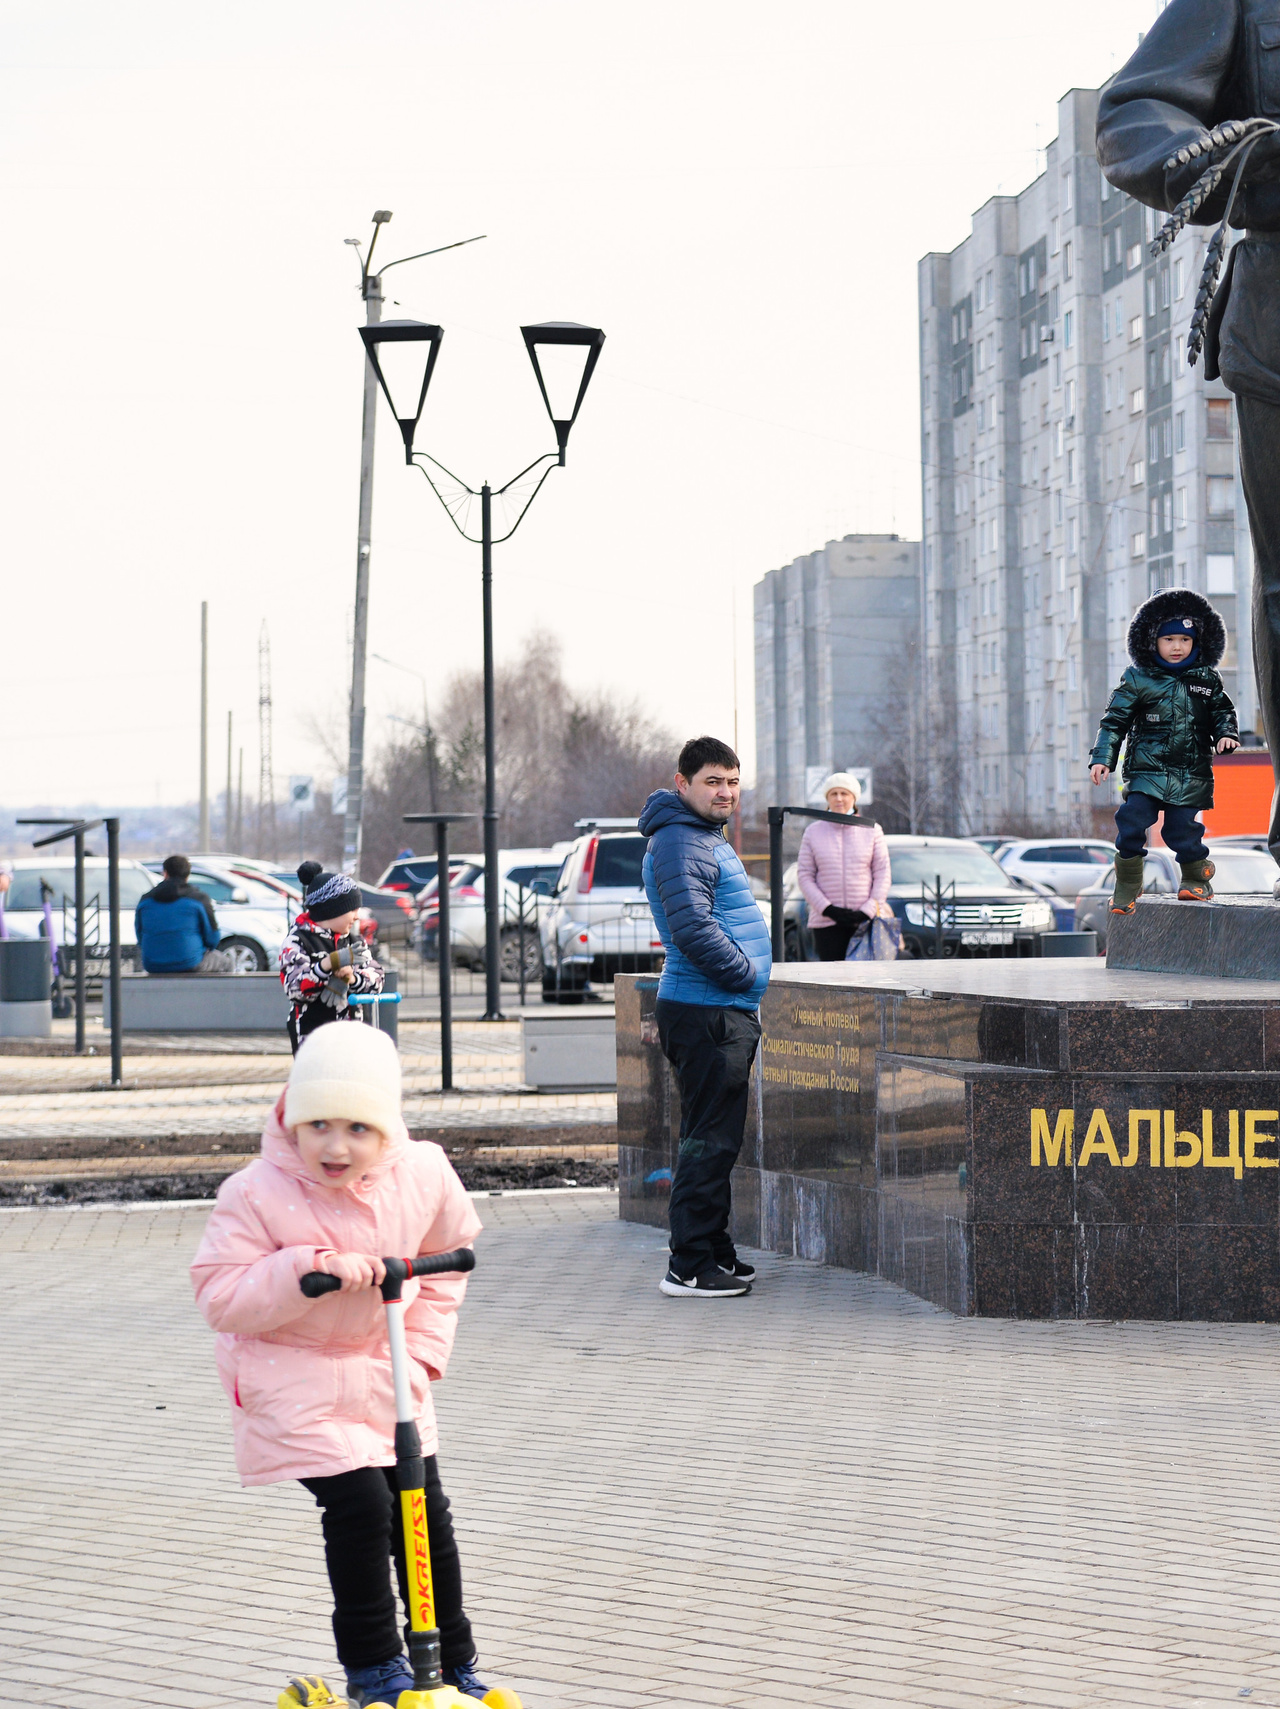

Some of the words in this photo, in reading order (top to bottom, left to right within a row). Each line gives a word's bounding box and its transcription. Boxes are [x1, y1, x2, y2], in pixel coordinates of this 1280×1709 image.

[761, 1032, 834, 1059] Социалистического
[836, 1041, 860, 1067] Труда
[789, 1069, 829, 1090] гражданин
[830, 1069, 859, 1094] России
[411, 1494, 431, 1599] KREISS
